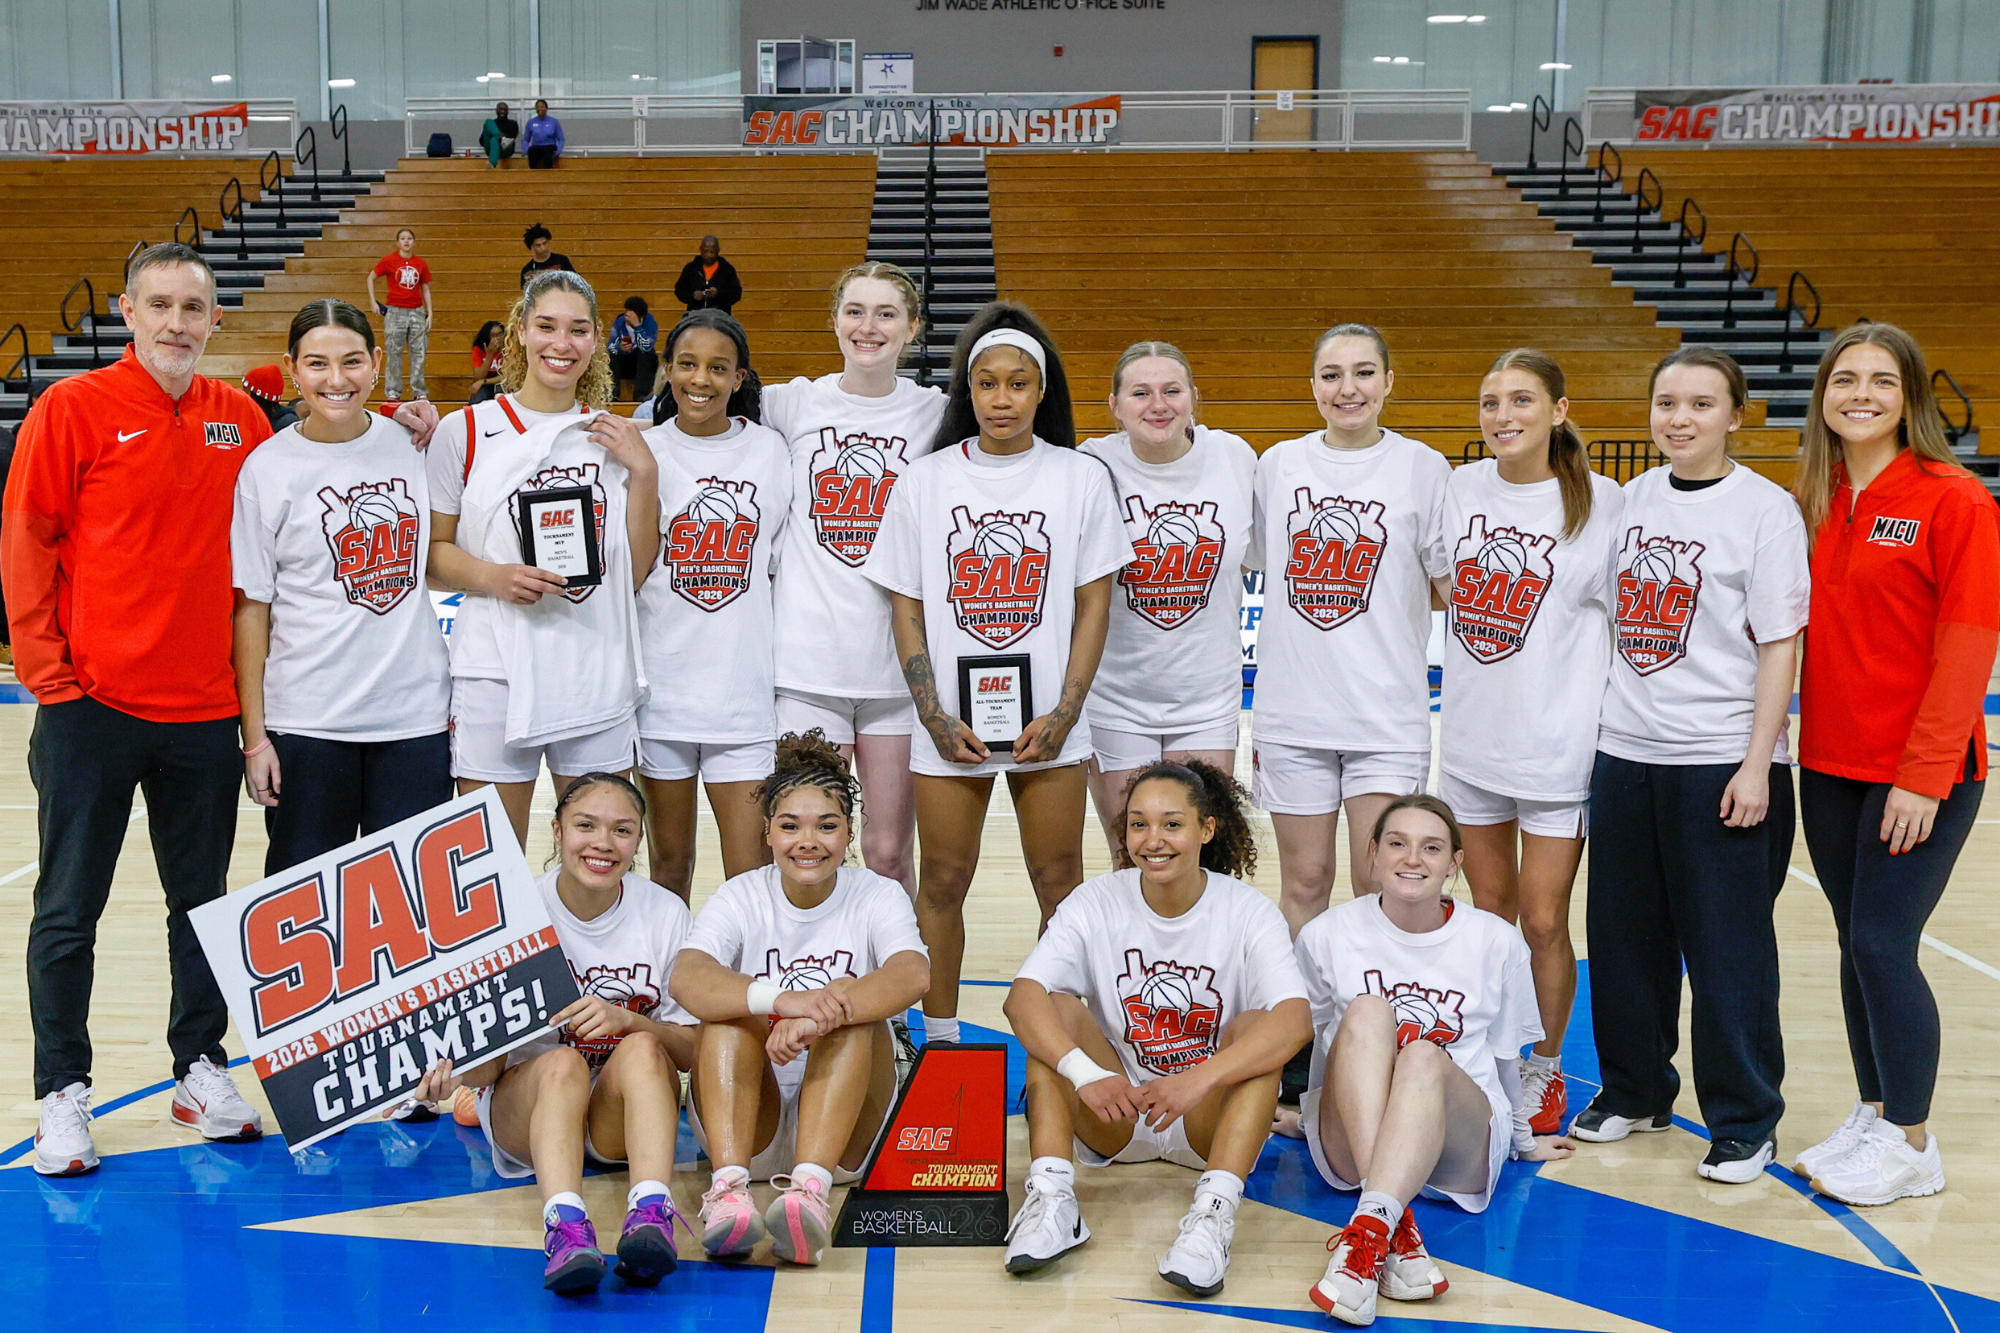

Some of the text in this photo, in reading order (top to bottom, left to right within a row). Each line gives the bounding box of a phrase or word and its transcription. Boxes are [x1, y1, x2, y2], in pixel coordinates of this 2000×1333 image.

[916, 0, 1165, 10] JIM WADE ATHLETIC OFFICE SUITE
[864, 99, 923, 107] Welcome
[950, 98, 972, 107] the
[63, 108, 74, 116] to
[82, 106, 102, 116] the
[744, 108, 1118, 145] SAC CHAMPIONSHIP
[1638, 105, 1719, 140] SAC
[204, 422, 242, 446] MACU
[540, 508, 574, 528] SAC
[824, 520, 880, 528] WOMEN'S BASKETB
[544, 532, 574, 540] TOURNAMENT
[820, 531, 877, 542] CHAMPIO
[1868, 516, 1920, 546] MACU
[338, 517, 418, 577] SAC
[668, 519, 758, 562] SAC
[842, 544, 867, 555] 2026
[1122, 541, 1222, 584] SAC
[1286, 537, 1382, 584] SAC
[702, 565, 742, 574] BASKETBALL
[951, 552, 1048, 600] SAC
[350, 576, 414, 600] CHAMPIONS
[674, 576, 747, 589] CHAMPIONS
[1136, 584, 1204, 594] WOMEN'S BASKETBALL
[1296, 582, 1362, 594] WOMEN'S BASKETBALL
[372, 592, 394, 605] 2026
[698, 590, 722, 600] 2026
[1452, 564, 1548, 621] SAC
[964, 600, 1034, 610] WOMEN'S BASKETBALL
[1131, 595, 1206, 608] CHAMPIONS
[1292, 594, 1366, 609] CHAMPIONS
[1616, 576, 1696, 627] SAC
[960, 612, 1038, 626] CHAMPIONS
[1155, 609, 1182, 619] 2026
[1312, 608, 1339, 619] 2026
[1459, 610, 1522, 630] WOMEN'S BASKETBALL
[984, 627, 1012, 638] 2026
[1455, 622, 1523, 648] CHAMPIONS
[1472, 639, 1498, 654] 2026
[1630, 652, 1658, 664] 2026
[977, 676, 1012, 693] SAC
[240, 802, 506, 1038] SAC
[266, 931, 550, 1074] 2026 WOMEN'S BASKETBALL
[322, 972, 508, 1072] TOURNAMENT
[1126, 1002, 1218, 1042] SAC
[312, 978, 548, 1122] CHAMPS!
[1140, 1046, 1216, 1065] CHAMPIONS
[896, 1127, 952, 1150] SAC
[928, 1164, 998, 1174] TOURNAMENT
[911, 1173, 998, 1187] CHAMPION
[860, 1210, 923, 1222] WOMEN'S
[853, 1220, 958, 1234] BASKETBALL
